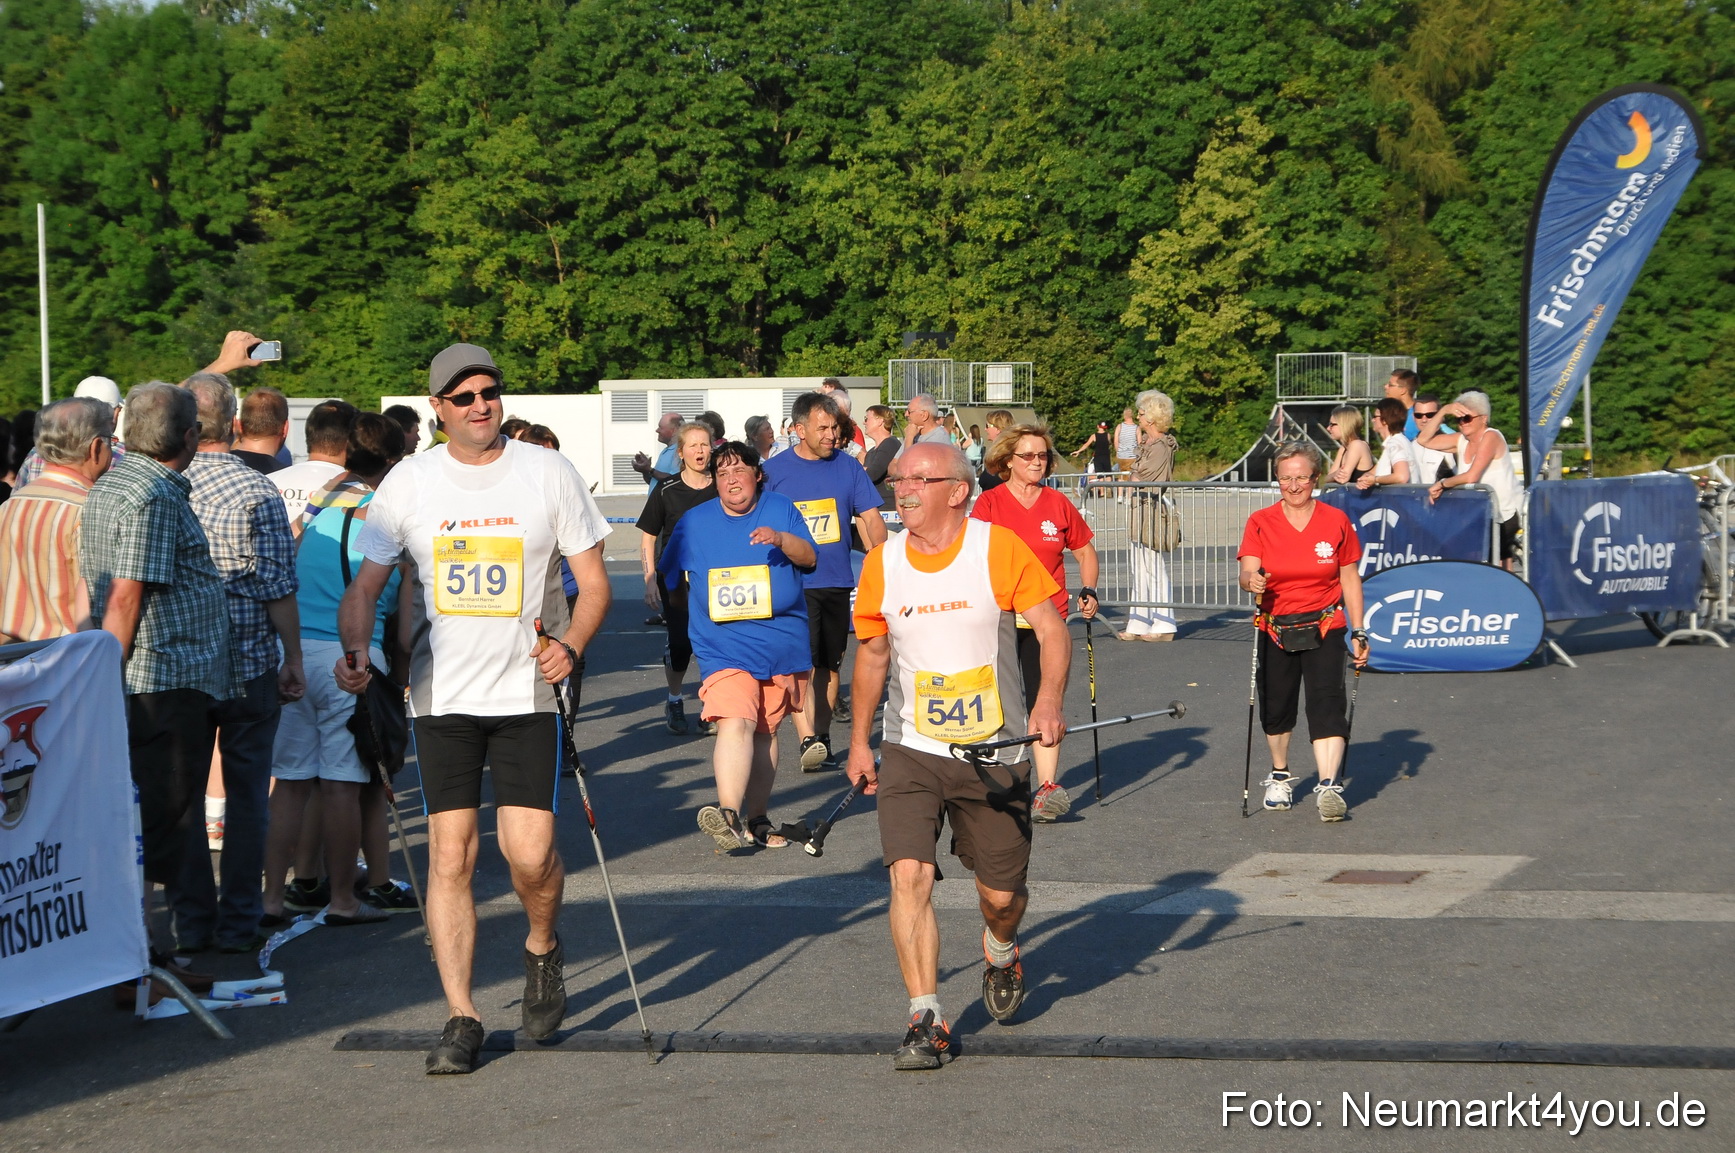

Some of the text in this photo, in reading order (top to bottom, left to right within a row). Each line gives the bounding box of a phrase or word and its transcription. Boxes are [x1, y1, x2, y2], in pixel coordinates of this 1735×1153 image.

[1616, 197, 1648, 237] Druck
[1537, 172, 1649, 328] Frischmann
[461, 517, 519, 529] KLEBL
[803, 515, 831, 533] 77
[1592, 534, 1676, 573] Fischer
[446, 564, 507, 596] 519
[1599, 576, 1669, 595] AUTOMOBILE
[717, 584, 758, 607] 661
[917, 600, 974, 614] KLEBL
[1391, 609, 1519, 635] Fischer
[1404, 635, 1510, 648] AUTOMOBILE
[927, 694, 983, 726] 541
